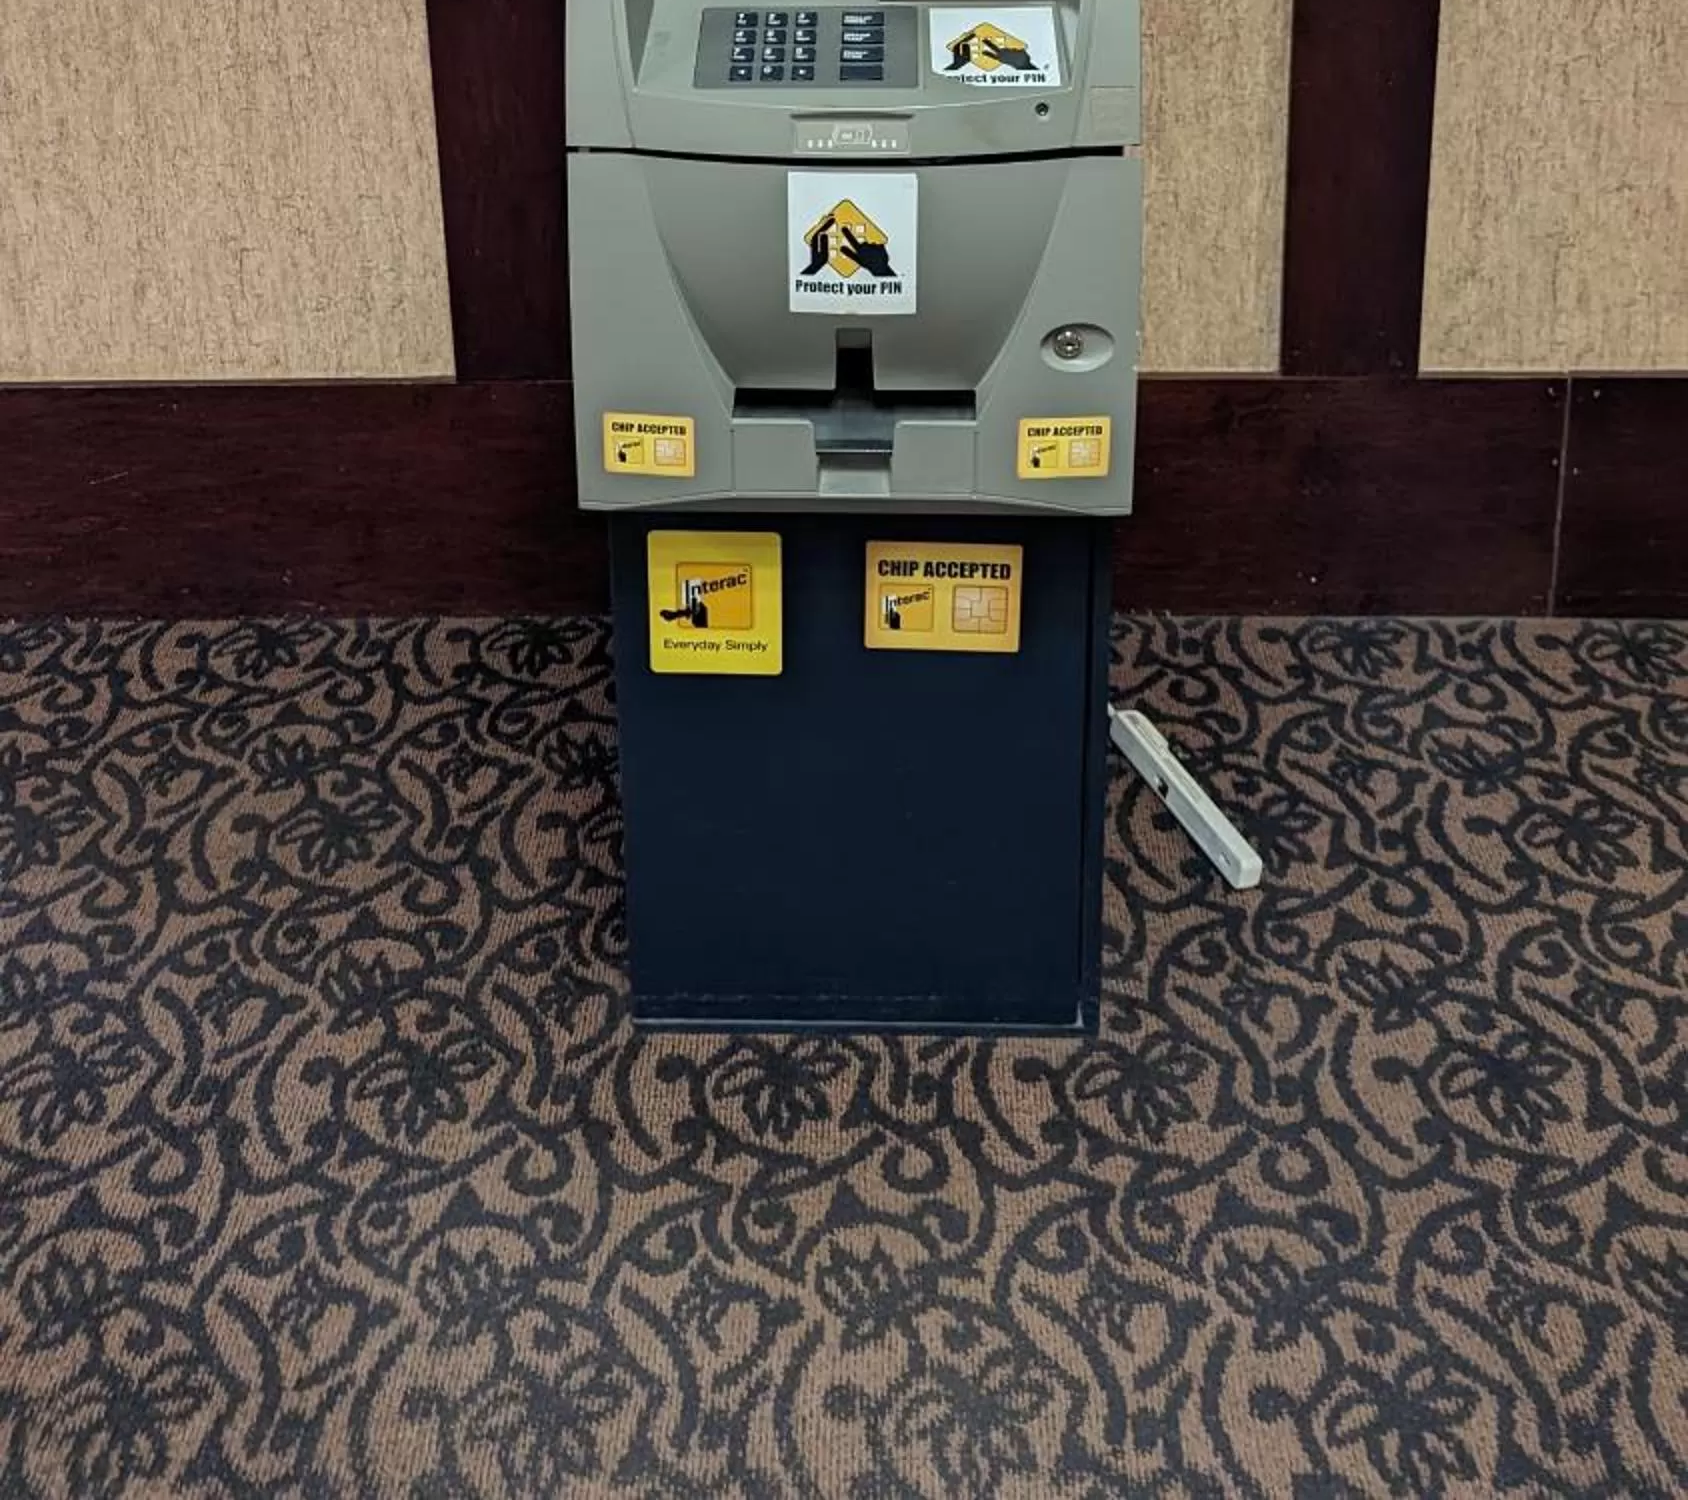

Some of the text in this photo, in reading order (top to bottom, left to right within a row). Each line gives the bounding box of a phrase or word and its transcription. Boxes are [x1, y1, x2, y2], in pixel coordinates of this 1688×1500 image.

[990, 74, 1020, 85] your
[1023, 73, 1046, 84] PIN
[795, 279, 903, 296] Protect your PIN
[611, 421, 687, 436] CHIP ACCEPTED
[1027, 425, 1103, 437] CHIP ACCEPTED
[877, 559, 1012, 580] CHIP ACCEPTED
[685, 573, 748, 607] Interac
[663, 637, 768, 653] Everyday Simply
